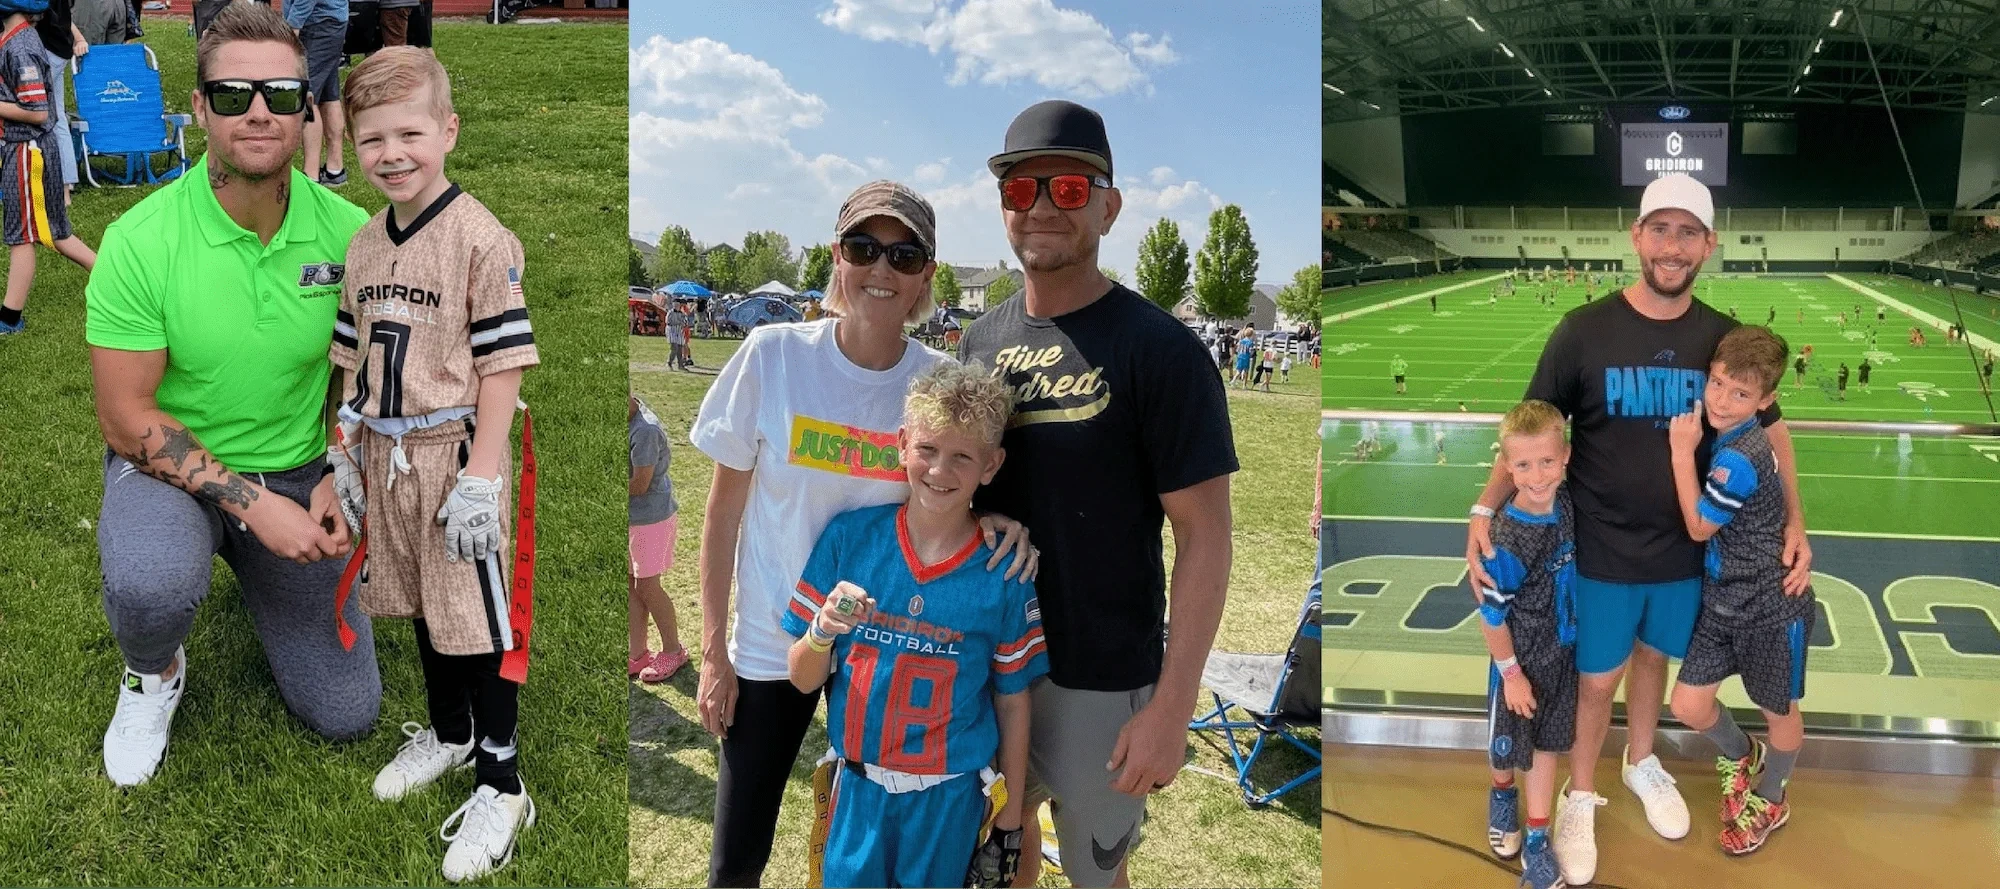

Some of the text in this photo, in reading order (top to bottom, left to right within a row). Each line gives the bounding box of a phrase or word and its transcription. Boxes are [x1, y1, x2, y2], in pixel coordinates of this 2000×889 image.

[1645, 158, 1703, 171] GRIDIRON
[990, 345, 1064, 378] Five
[1010, 366, 1104, 403] dred
[795, 428, 900, 471] JUST DO
[855, 624, 960, 656] FOOTBALL
[844, 643, 959, 775] 18
